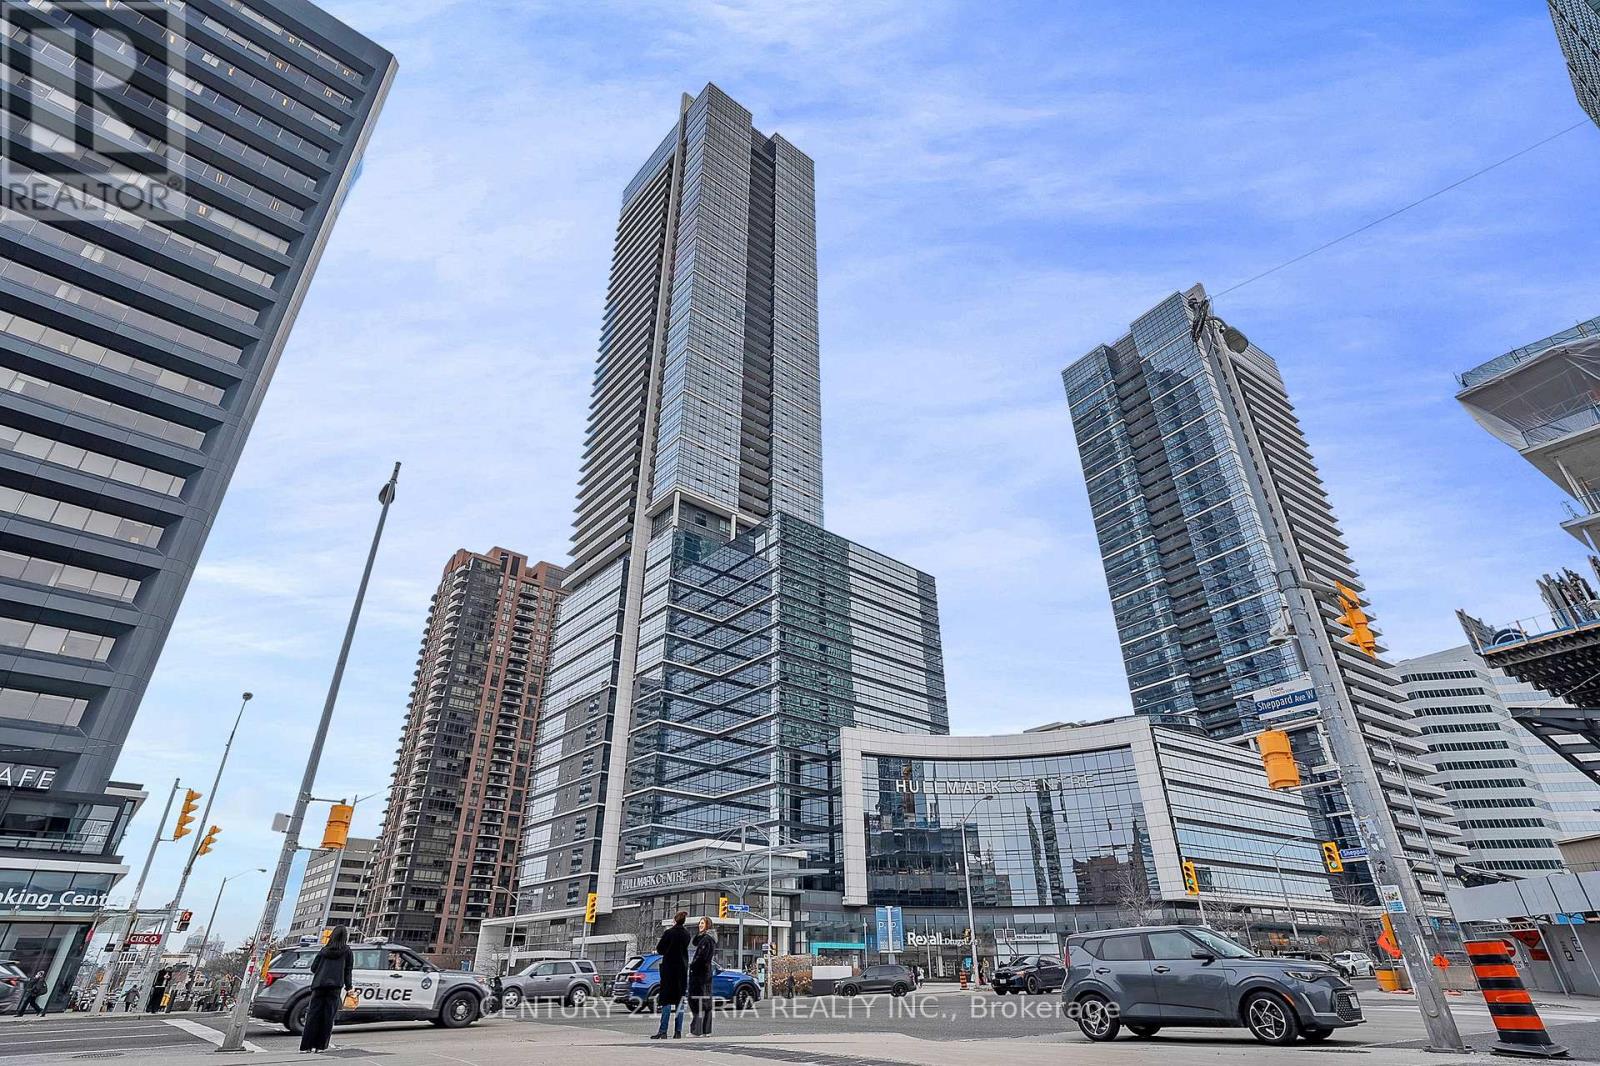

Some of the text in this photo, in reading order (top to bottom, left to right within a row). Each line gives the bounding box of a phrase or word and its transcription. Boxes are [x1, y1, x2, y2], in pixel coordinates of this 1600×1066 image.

[1256, 695, 1293, 712] Sheppard
[1294, 693, 1307, 703] Ave
[1306, 689, 1314, 700] W
[895, 774, 1095, 794] HULLMARK CENTRE
[621, 869, 688, 890] HULLMARK CENTRE
[130, 935, 150, 943] CIBC
[907, 931, 943, 947] Rexall
[354, 987, 413, 1001] POLICE
